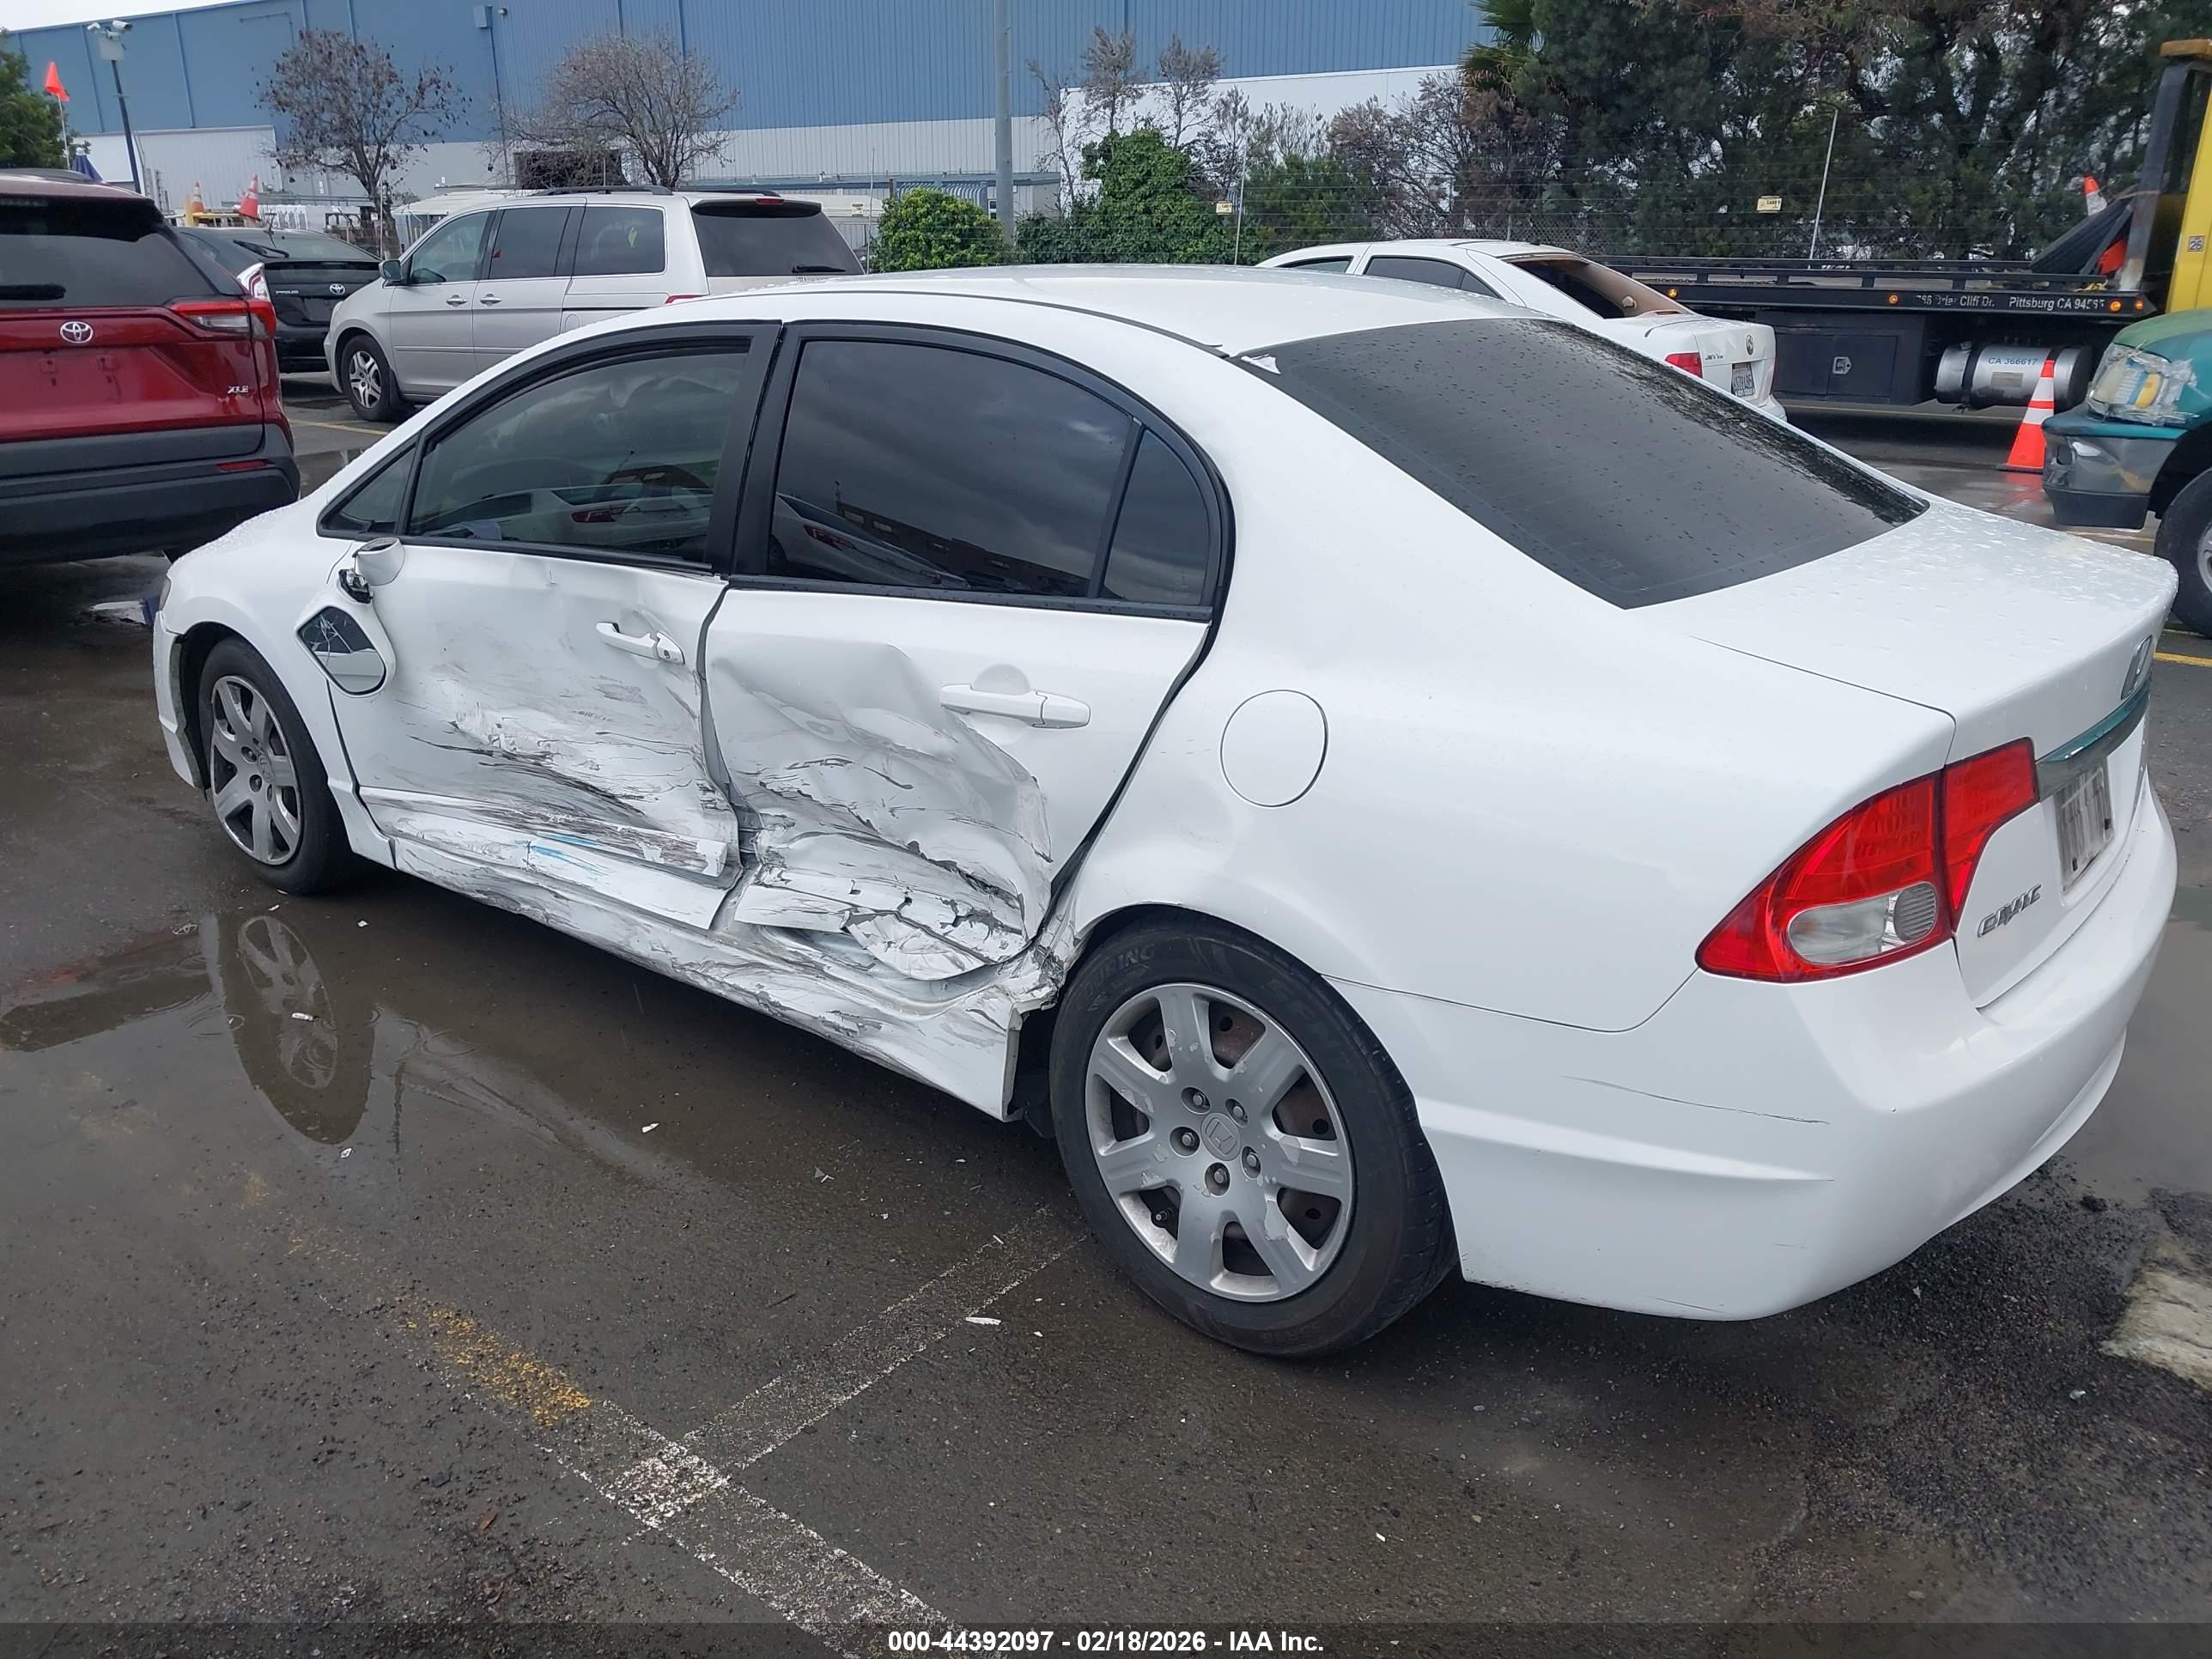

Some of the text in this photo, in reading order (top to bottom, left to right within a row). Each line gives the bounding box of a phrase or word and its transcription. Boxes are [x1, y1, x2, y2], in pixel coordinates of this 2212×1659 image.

[1960, 295, 1981, 307] Cliff
[2008, 296, 2054, 311] Pittsburg
[2057, 297, 2072, 309] CA
[1978, 884, 2042, 938] CIVIC
